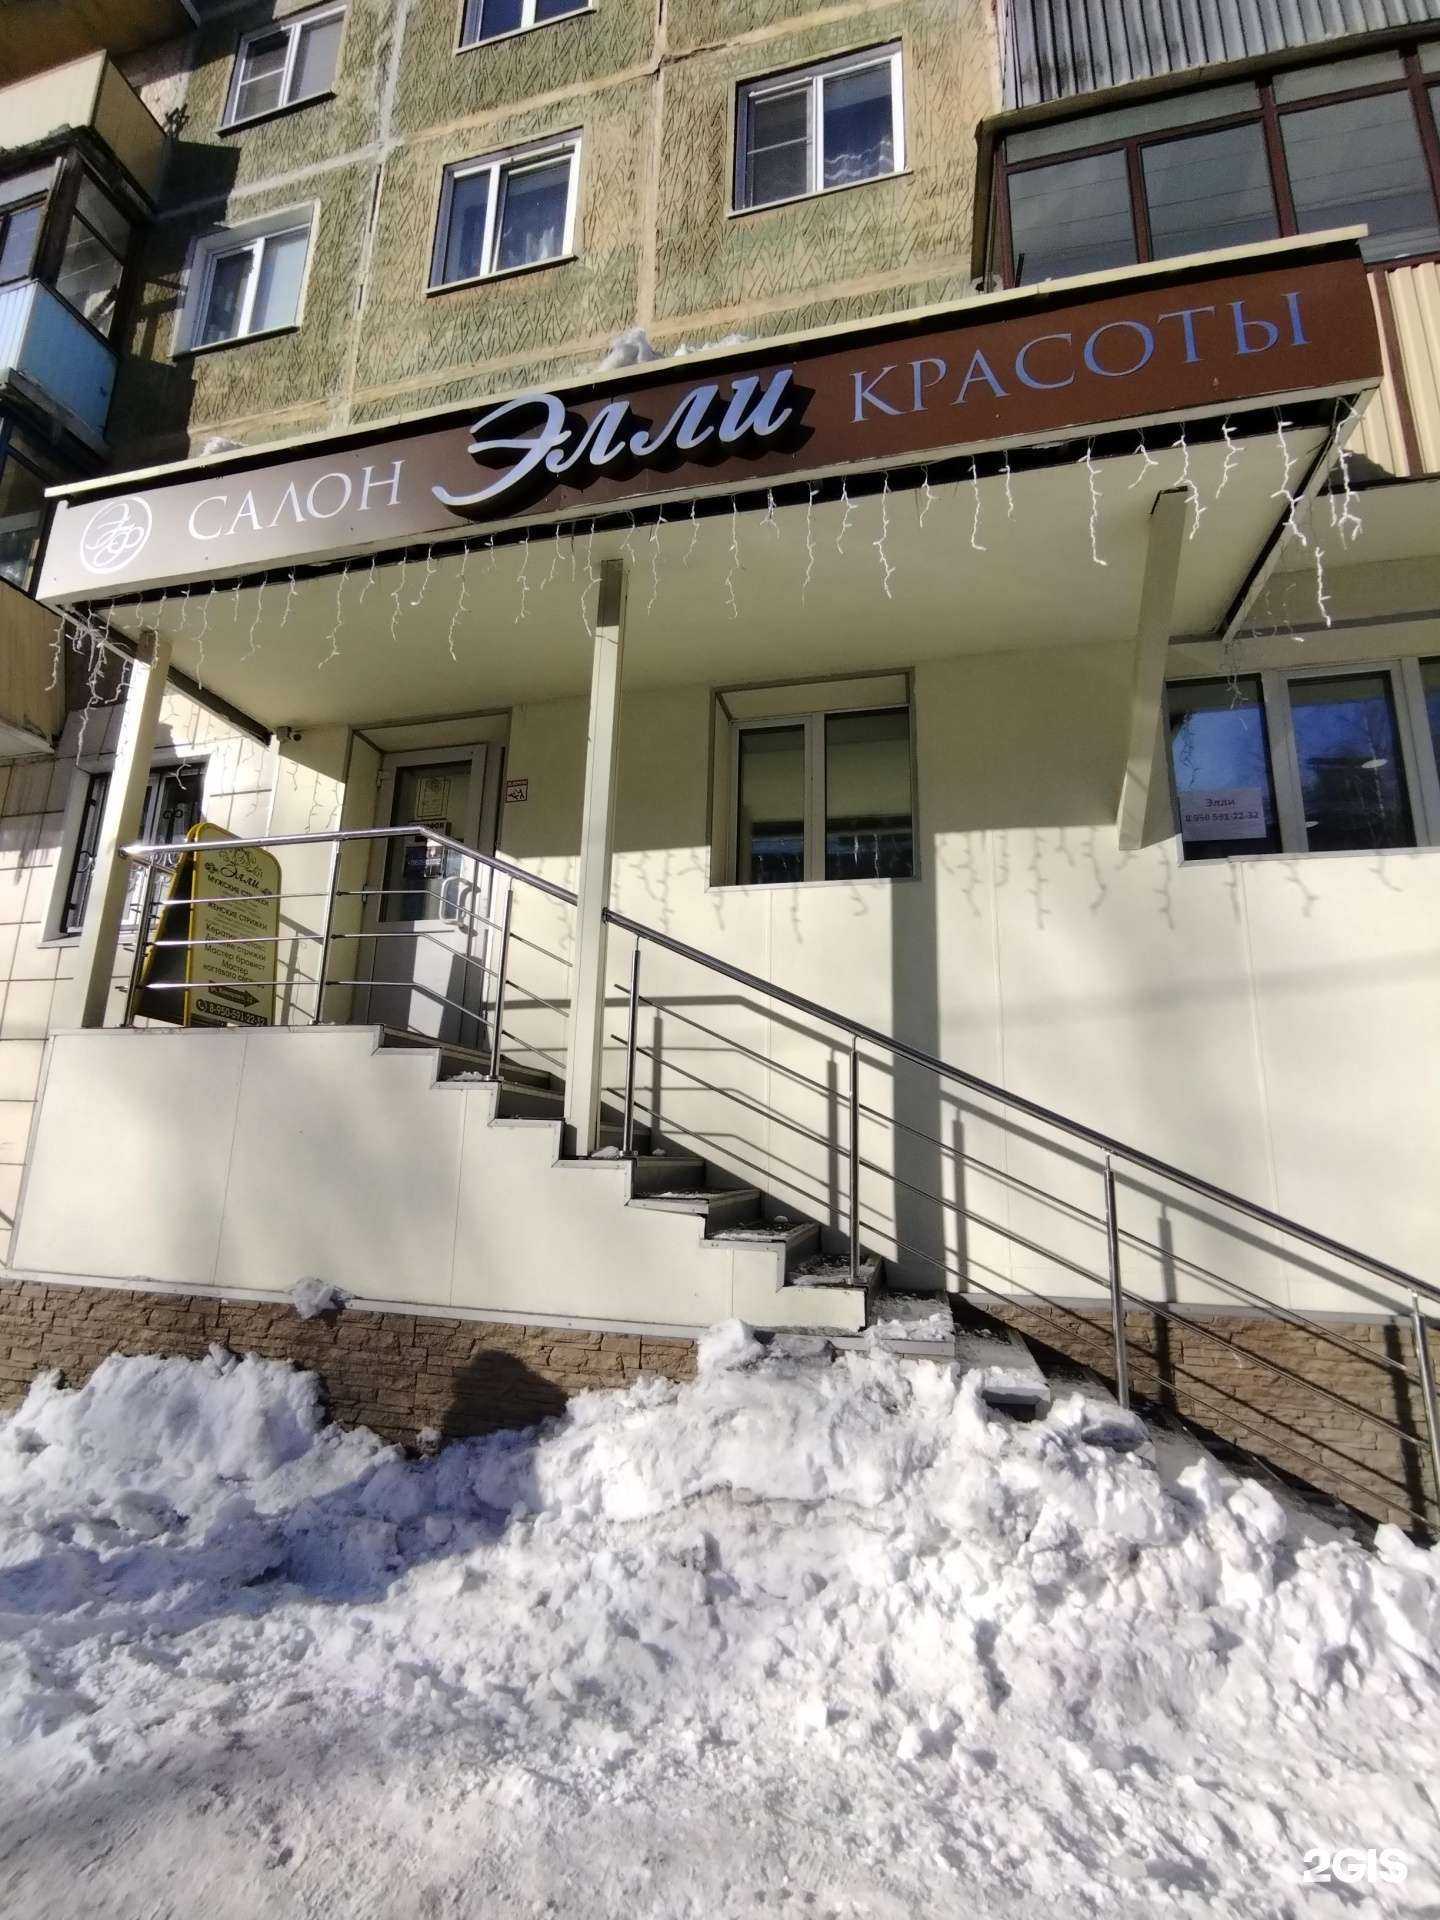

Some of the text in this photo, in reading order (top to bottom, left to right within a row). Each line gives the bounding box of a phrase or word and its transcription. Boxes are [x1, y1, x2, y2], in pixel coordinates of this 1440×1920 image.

[187, 460, 405, 541] САЛОН
[431, 369, 793, 506] Элли
[849, 292, 1310, 423] КРАСОТЫ
